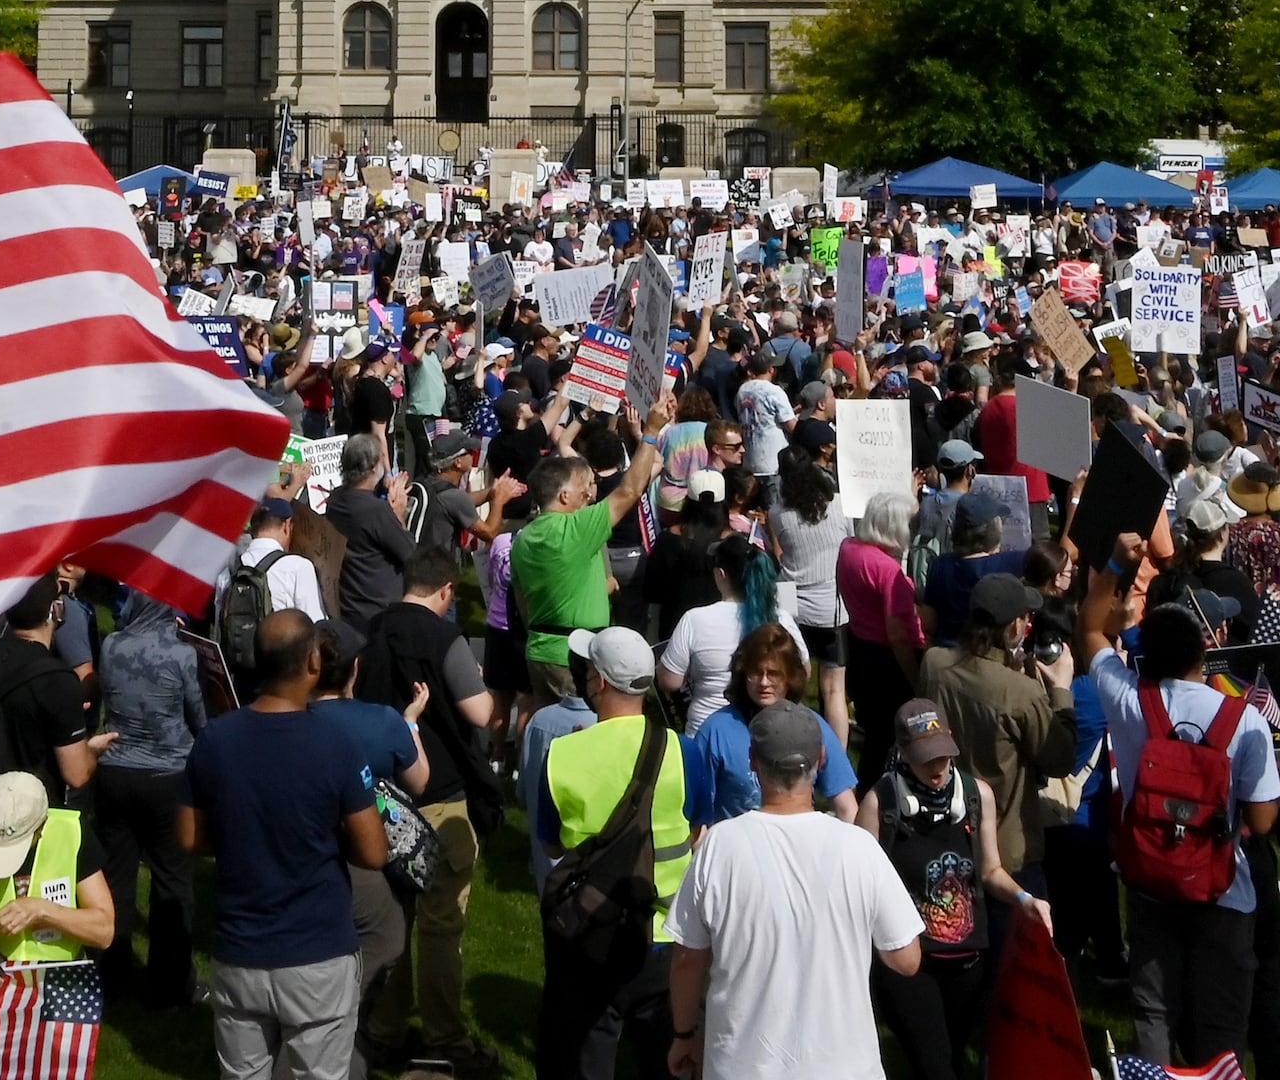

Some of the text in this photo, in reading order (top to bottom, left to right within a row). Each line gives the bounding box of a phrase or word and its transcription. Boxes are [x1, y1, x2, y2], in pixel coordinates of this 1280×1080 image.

[197, 177, 227, 191] RESIST.
[698, 234, 722, 255] HATE
[1205, 255, 1221, 274] NO
[1135, 269, 1201, 285] SOLIDARITY
[1149, 284, 1177, 295] WITH
[1141, 295, 1178, 307] CIVIL
[1135, 308, 1195, 322] SERVICE
[205, 323, 233, 334] KINGS
[209, 335, 220, 346] IN
[595, 330, 631, 350] I DID
[218, 347, 237, 357] RICA
[304, 440, 344, 455] NO THRONE
[317, 452, 342, 462] CROW
[641, 492, 656, 547] DID THAT!
